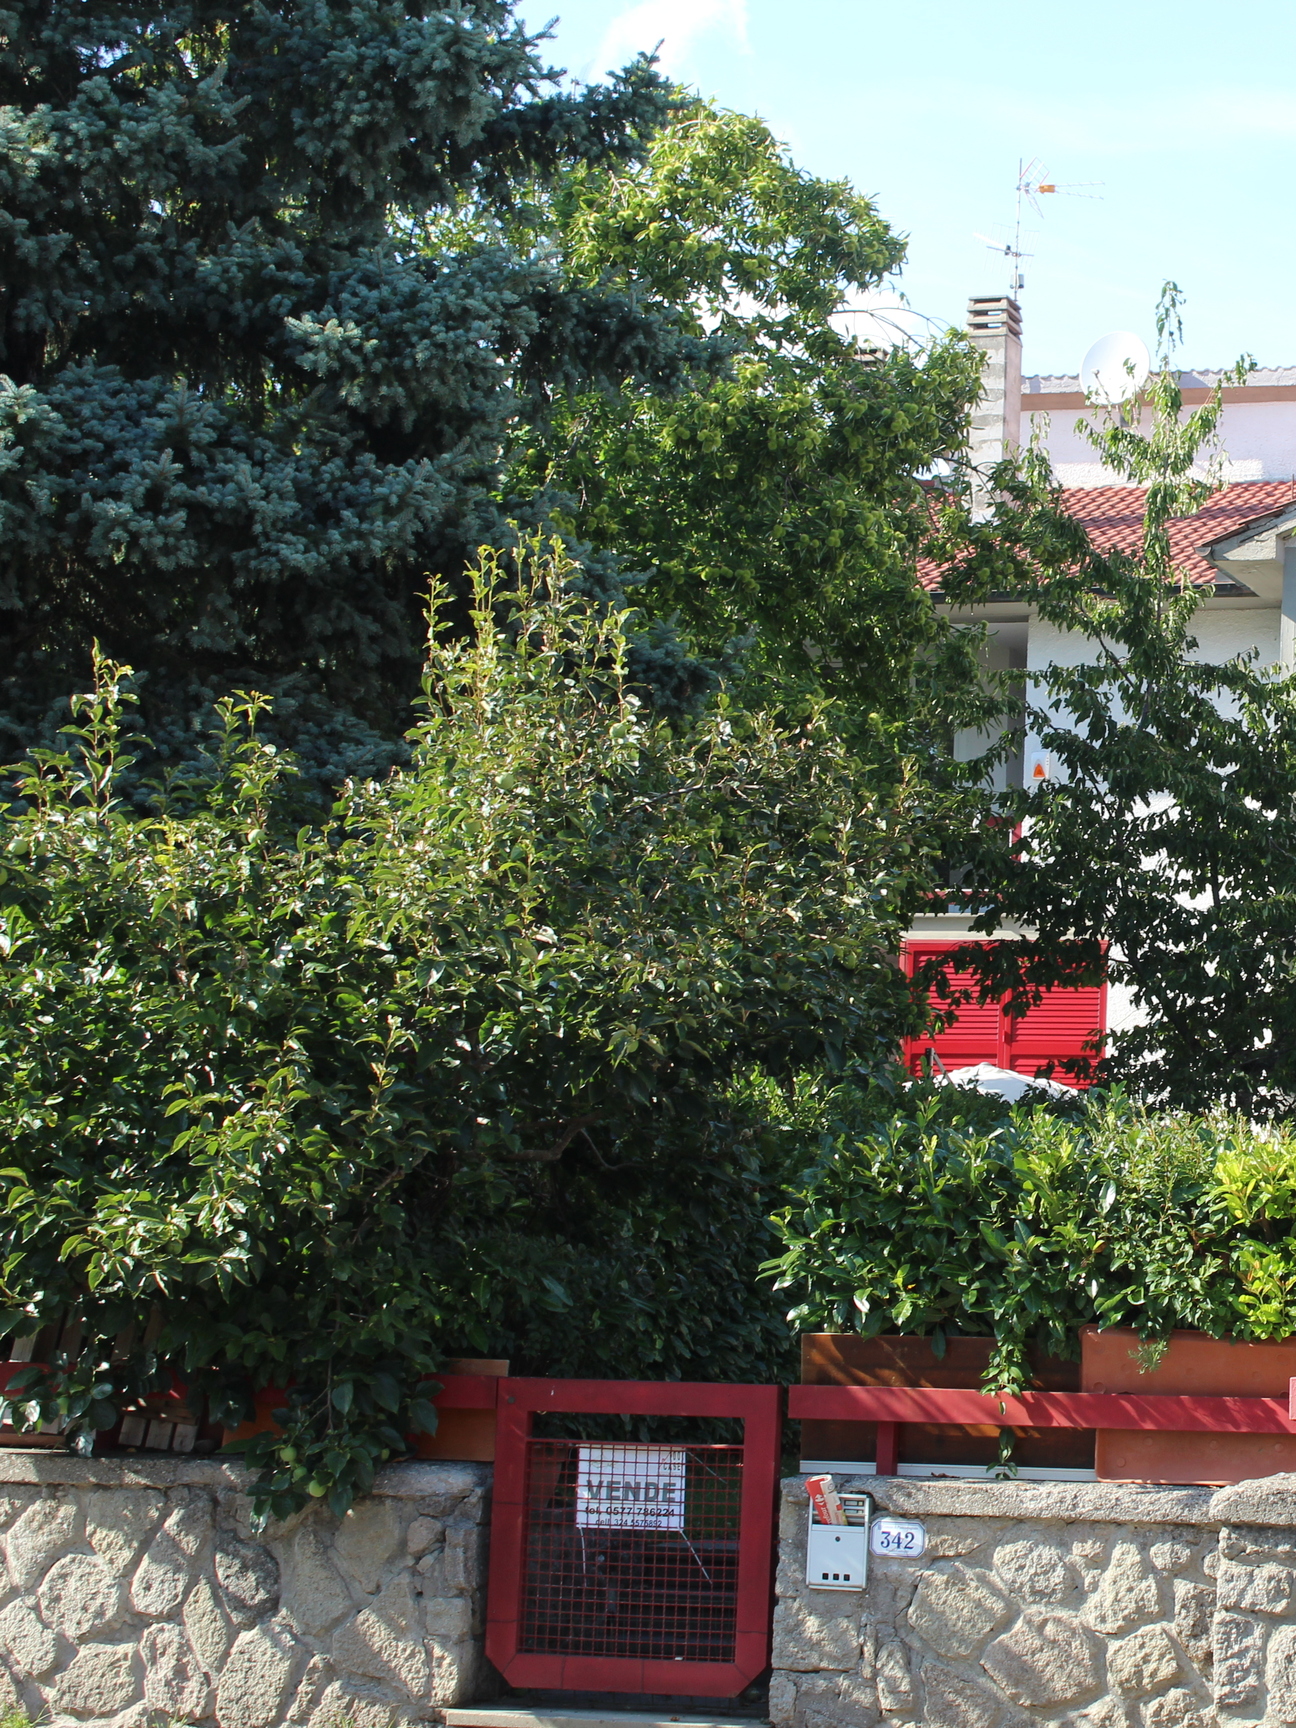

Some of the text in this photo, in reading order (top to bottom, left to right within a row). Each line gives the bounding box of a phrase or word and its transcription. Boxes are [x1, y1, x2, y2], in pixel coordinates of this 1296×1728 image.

[586, 1479, 677, 1502] VENDE
[605, 1506, 633, 1516] 0577
[636, 1507, 675, 1517] 786224
[613, 1518, 628, 1526] 324
[880, 1531, 915, 1549] 342
